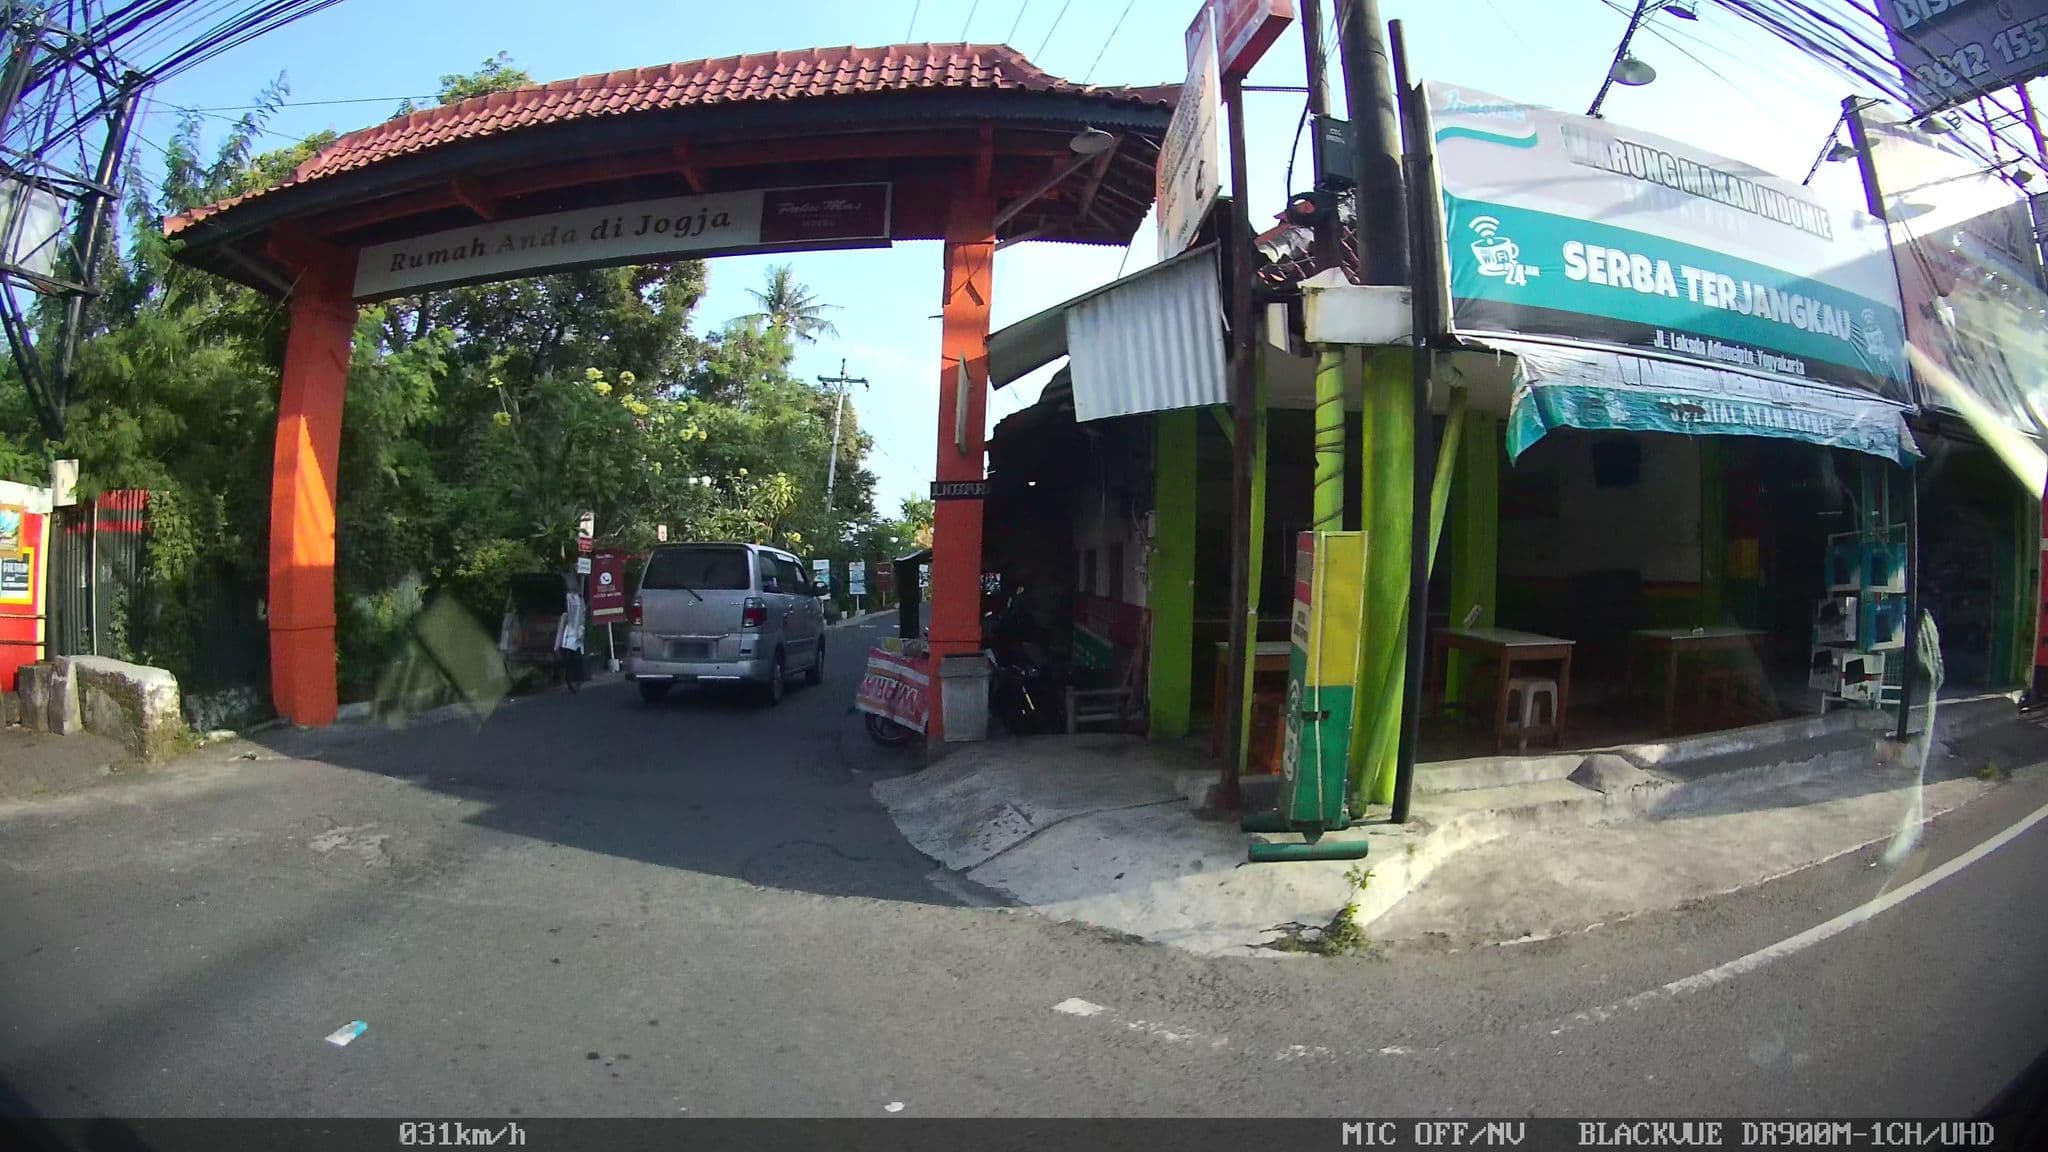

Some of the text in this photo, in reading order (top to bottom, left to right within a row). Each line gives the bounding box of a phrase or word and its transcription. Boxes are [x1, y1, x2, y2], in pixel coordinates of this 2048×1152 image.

[1679, 157, 1758, 214] MAKAN
[1756, 183, 1834, 242] INDOMIE
[390, 207, 731, 272] Rumah Anda di Jogja
[1562, 240, 1679, 298] SERBA
[1680, 264, 1850, 341] TERJANGKAU
[1670, 332, 1706, 355] Laksda
[1756, 349, 1805, 375] Yogyakarta
